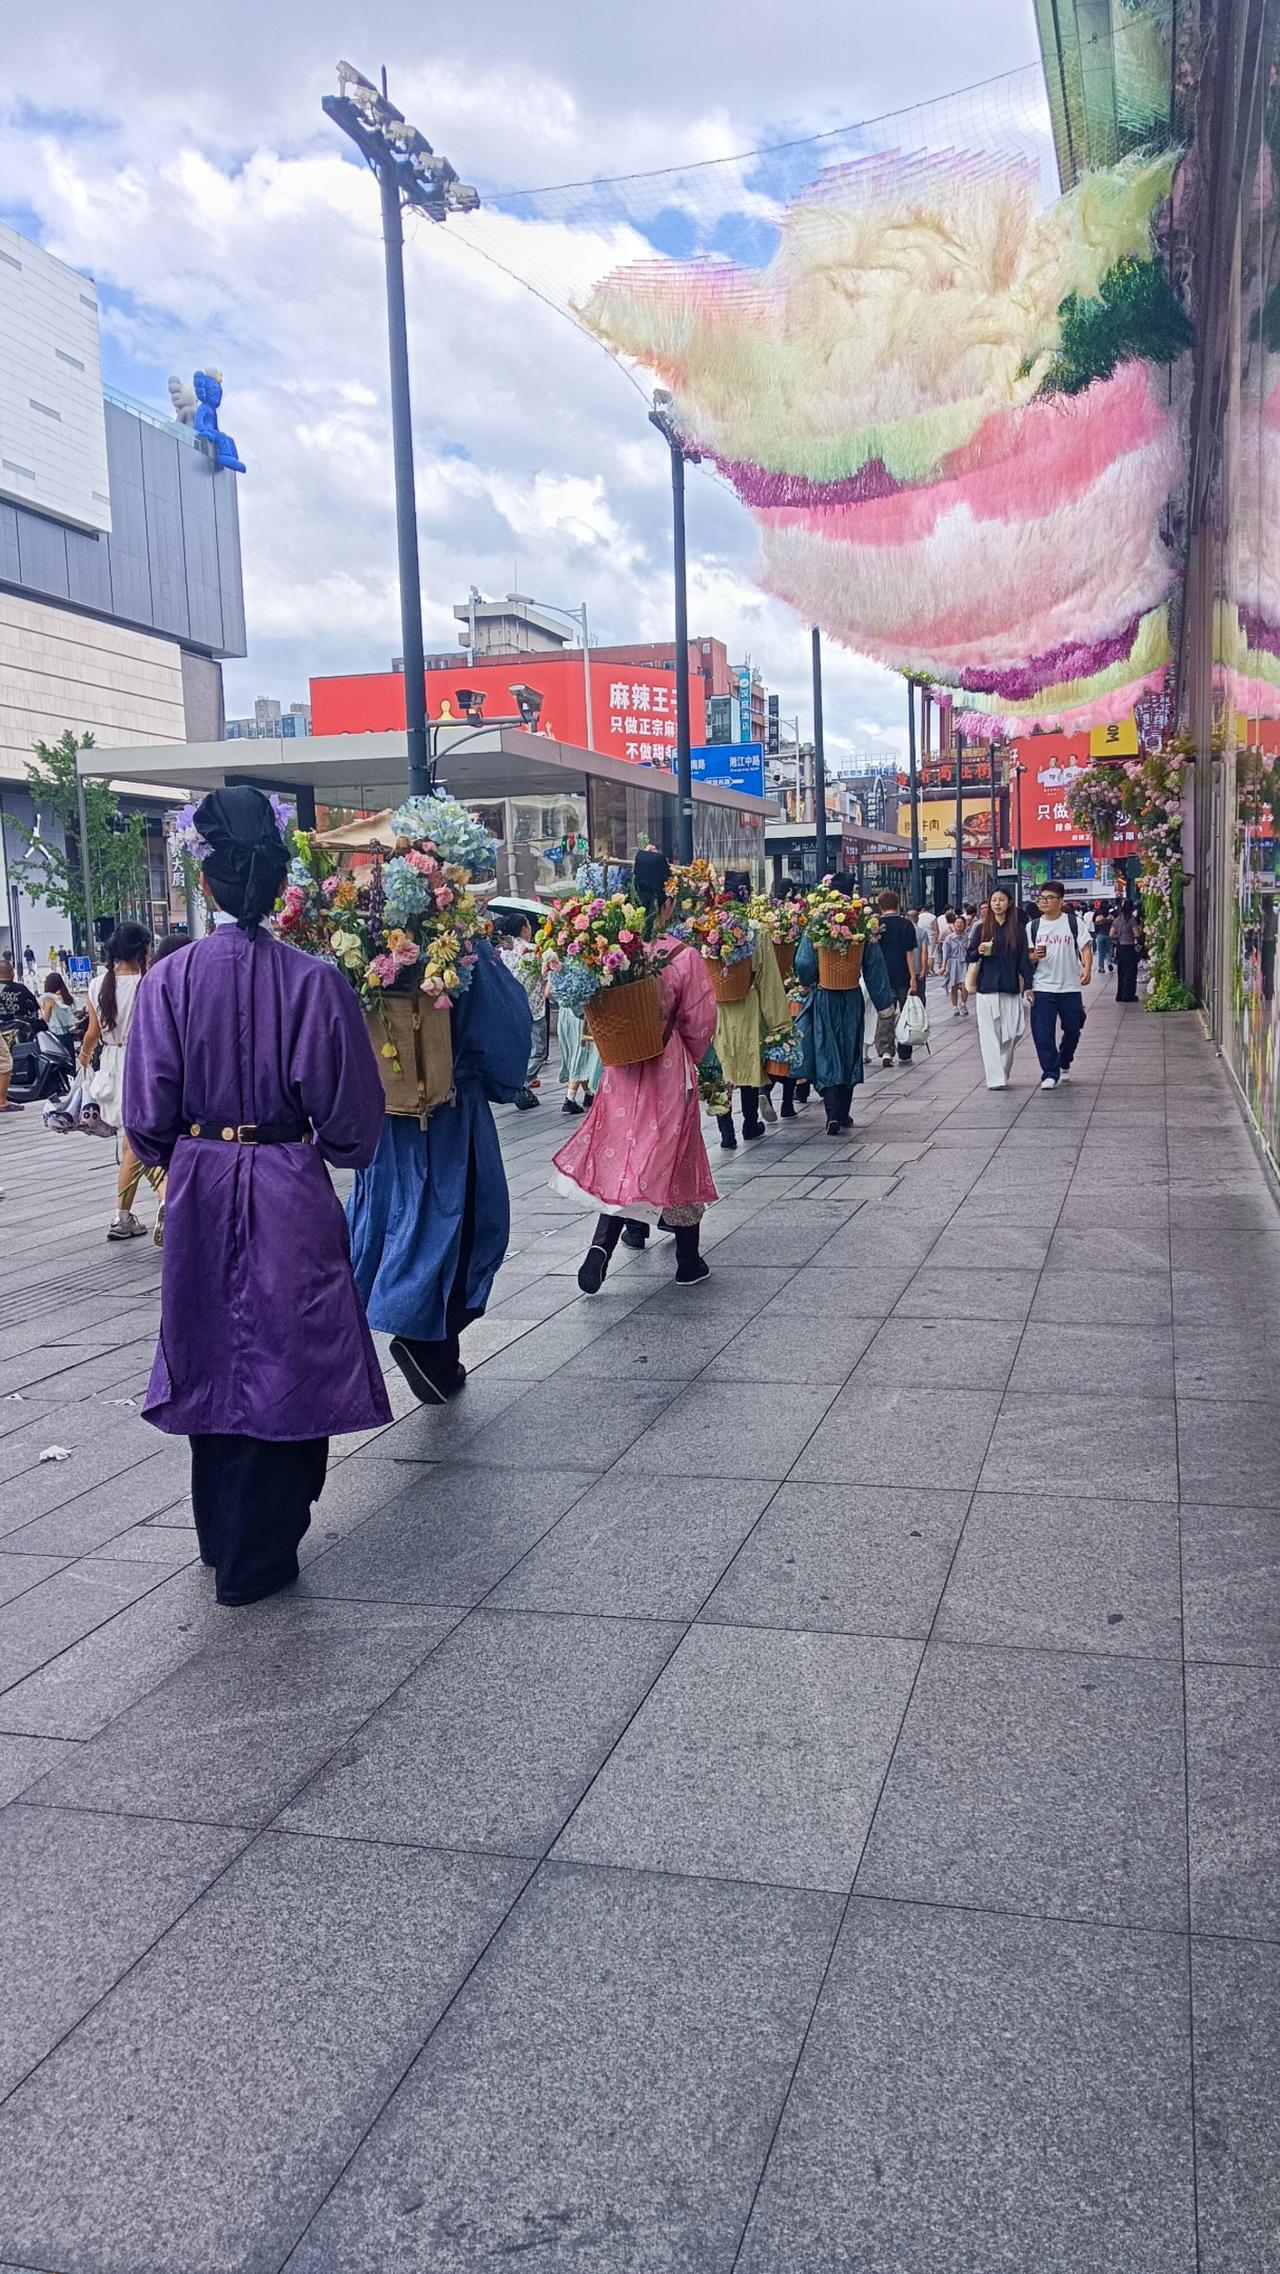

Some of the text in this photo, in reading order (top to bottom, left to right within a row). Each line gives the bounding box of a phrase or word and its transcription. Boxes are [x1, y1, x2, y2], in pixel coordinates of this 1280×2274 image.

[610, 716, 677, 738] 只做正宗麻
